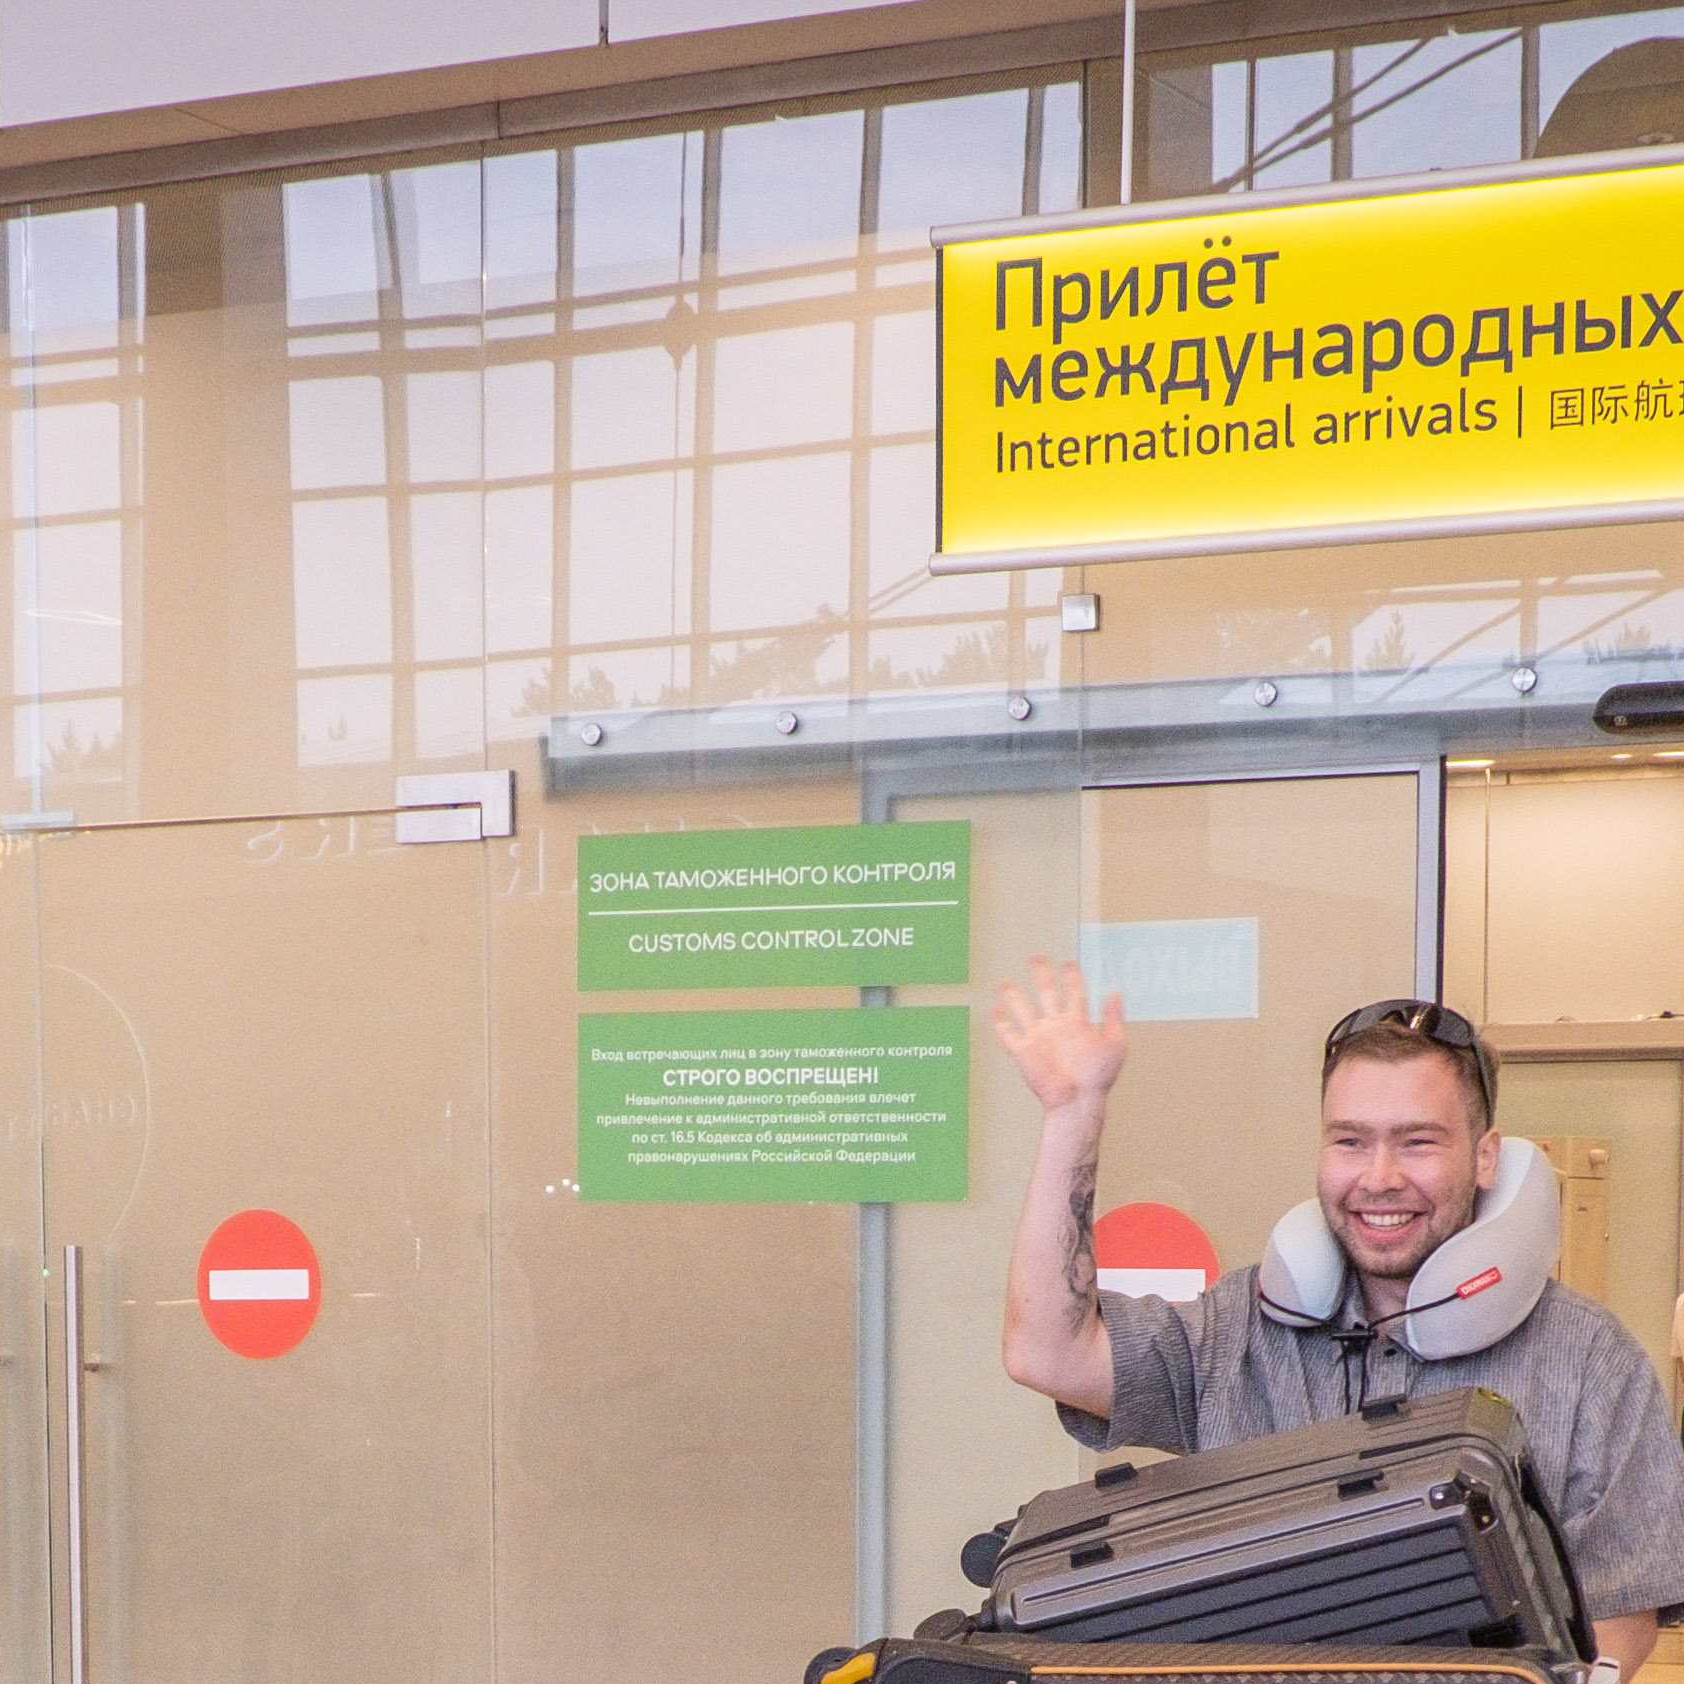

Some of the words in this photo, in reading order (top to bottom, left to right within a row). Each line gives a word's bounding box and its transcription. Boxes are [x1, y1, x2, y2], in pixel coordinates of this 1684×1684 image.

[994, 236, 1281, 342] Прилёт
[993, 286, 1684, 408] международных
[995, 403, 1296, 474] International
[1311, 389, 1498, 445] arrivals
[590, 872, 651, 894] ЗОНА
[652, 865, 829, 890] ТАМОЖЕННОГО
[832, 861, 956, 885] КОНТРОЛЯ
[628, 931, 737, 954] CUSTOMS
[740, 928, 850, 951] CONTROL
[850, 927, 914, 948] ZONE
[591, 1048, 625, 1063] Вход
[625, 1050, 718, 1063] встречающих
[719, 1049, 747, 1061] лиц
[748, 1049, 757, 1059] в
[759, 1048, 792, 1062] зону
[793, 1046, 885, 1059] таможенного
[887, 1045, 953, 1060] контроля
[662, 1068, 742, 1087] СТРОГО
[744, 1067, 879, 1088] ВОСПРЕЩЕН!
[625, 1093, 726, 1107] Невыполнение
[725, 1094, 784, 1107] данного
[785, 1091, 866, 1107] требования
[596, 1114, 684, 1128] привлечение
[685, 1115, 693, 1124] к
[695, 1110, 826, 1127] административной
[828, 1112, 947, 1124] ответственности
[631, 1133, 649, 1145] по
[650, 1133, 668, 1144] ст.
[670, 1129, 696, 1144] 16.5
[697, 1130, 754, 1146] Кодекса
[755, 1129, 774, 1144] об
[774, 1132, 908, 1146] административных
[627, 1152, 749, 1166] правонарушениях
[751, 1148, 833, 1163] Российской
[835, 1148, 916, 1165] Федерации
